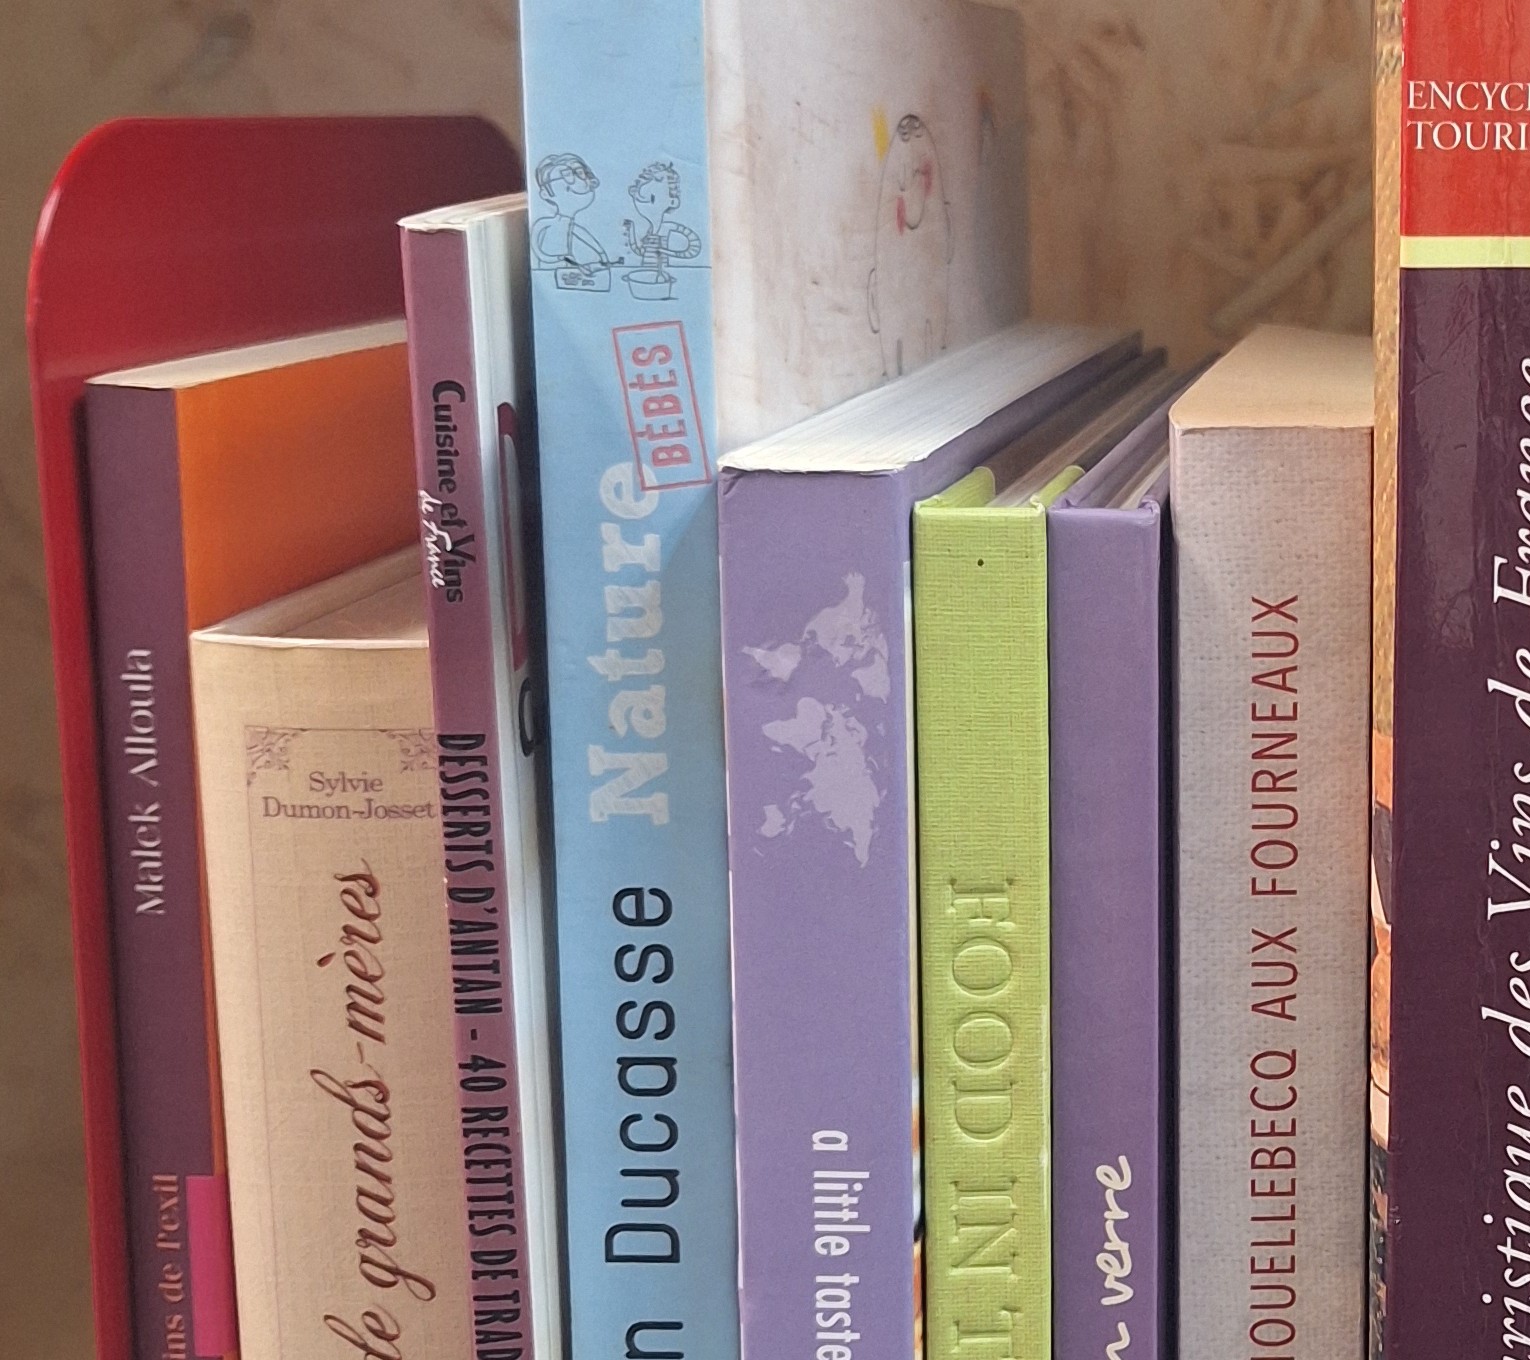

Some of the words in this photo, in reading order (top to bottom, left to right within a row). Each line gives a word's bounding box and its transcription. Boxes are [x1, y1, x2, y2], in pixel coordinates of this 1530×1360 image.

[432, 380, 466, 493] Cuisine
[627, 341, 694, 468] BÉBÉS
[419, 490, 442, 515] de
[441, 503, 467, 529] et
[445, 534, 476, 603] Vins
[590, 462, 672, 825] Nature
[120, 649, 158, 787] Alloula
[1250, 595, 1301, 897] FOURNEAUX
[262, 797, 436, 822] Dumon-Josset
[309, 771, 383, 797] Sylvie
[439, 733, 494, 874] DESSERTS
[128, 802, 164, 915] Malek
[446, 885, 502, 1015] D'ANTAN
[1250, 925, 1300, 1022] AUX
[949, 878, 1017, 1142] FOOD
[310, 858, 436, 1302] grands-mères
[459, 1054, 506, 1093] 40
[603, 886, 684, 1265] Ducasse
[462, 1106, 514, 1237] RECETTES
[811, 1131, 848, 1153] a
[470, 1248, 517, 1281] DE
[813, 1170, 871, 1258] little
[949, 1181, 1019, 1276] IN
[1094, 1155, 1136, 1307] verre
[157, 1263, 183, 1303] de
